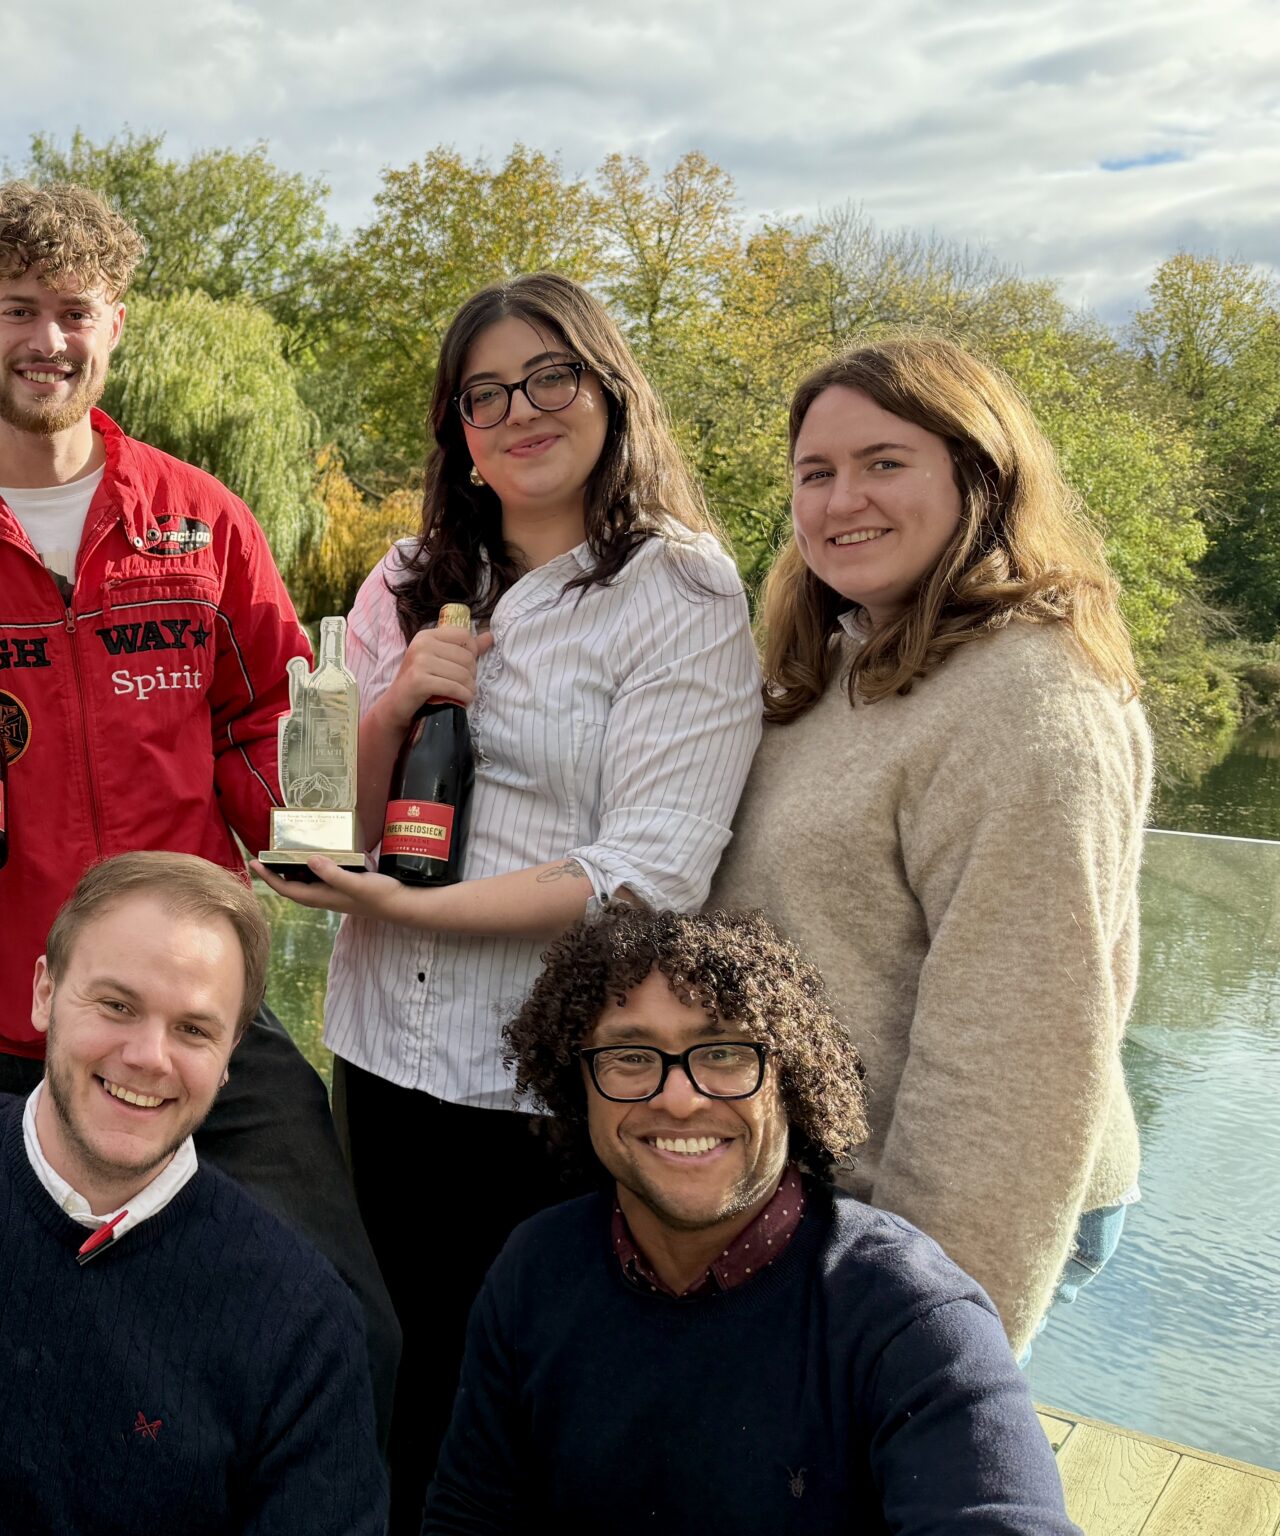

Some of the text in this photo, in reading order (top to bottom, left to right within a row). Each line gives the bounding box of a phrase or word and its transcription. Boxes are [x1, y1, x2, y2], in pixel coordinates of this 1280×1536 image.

[162, 529, 211, 542] raction
[95, 619, 192, 655] WAY
[111, 665, 202, 700] Spirit
